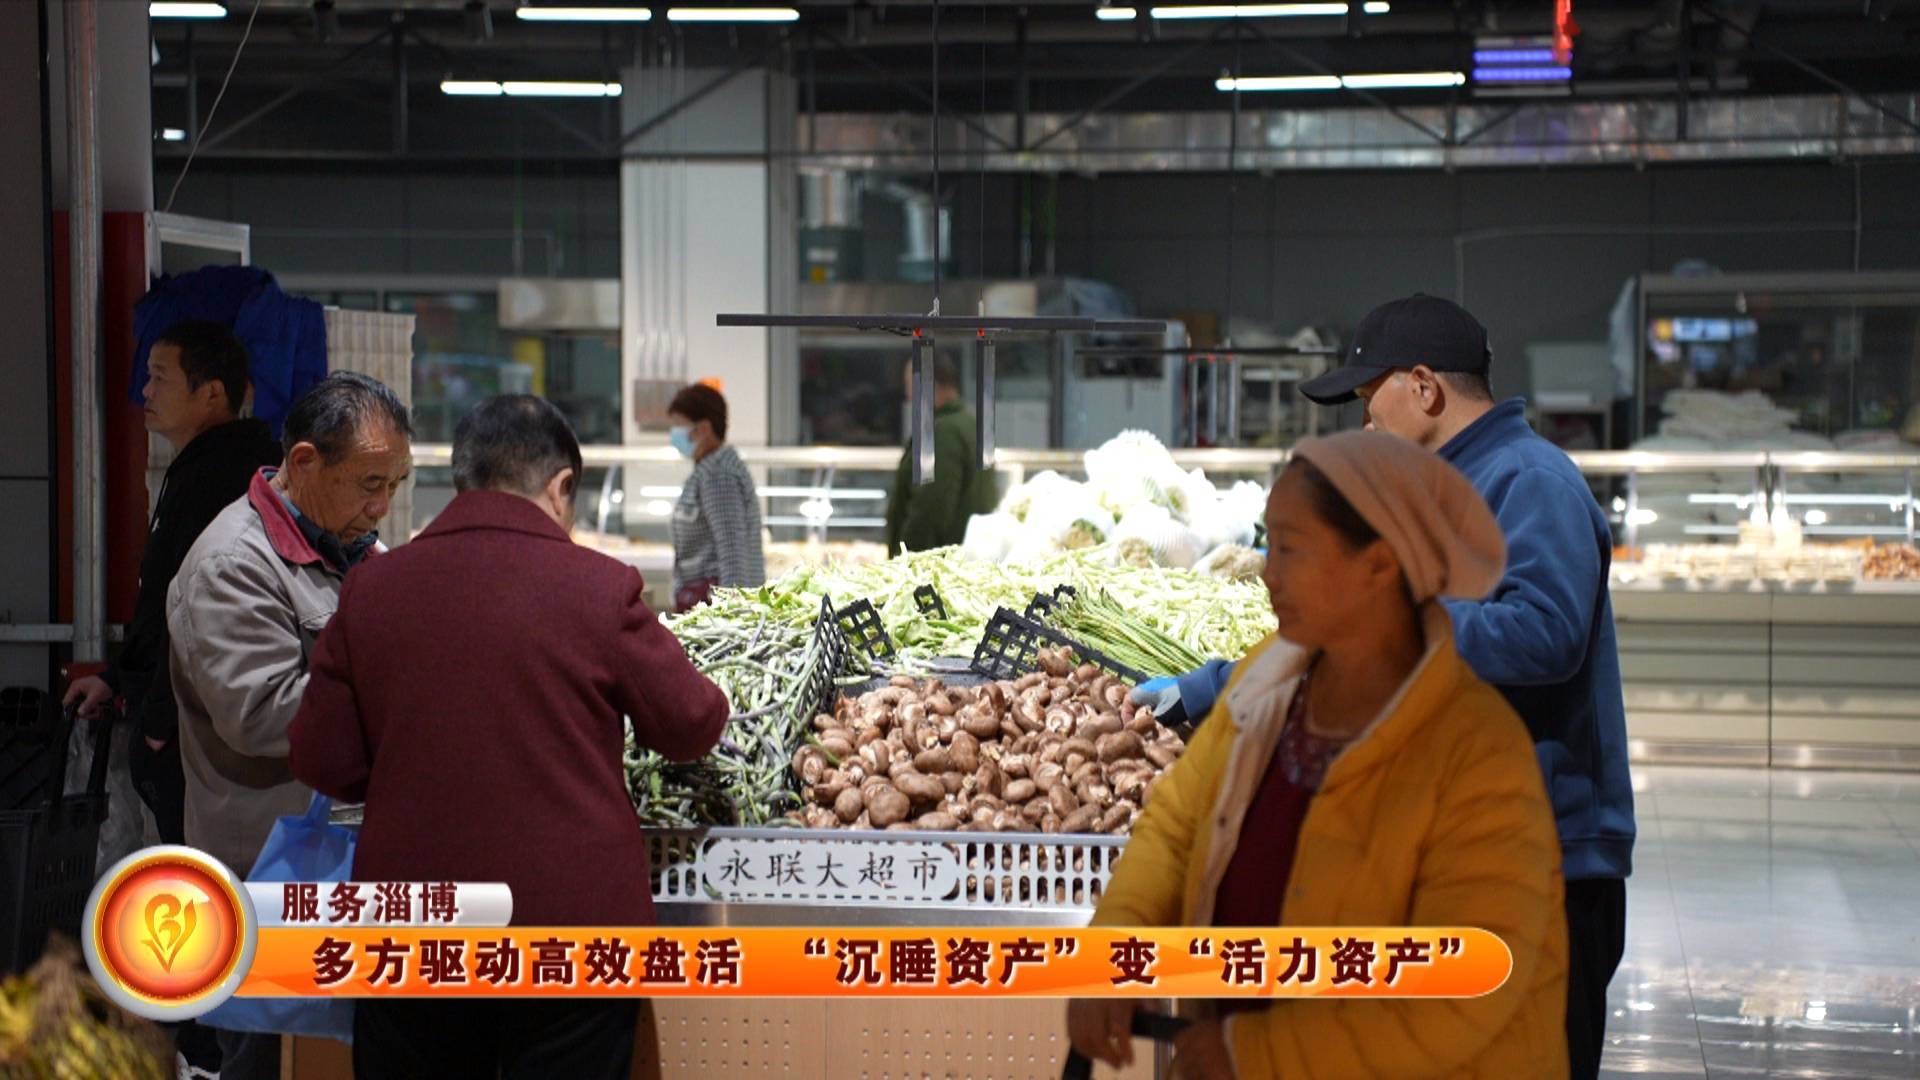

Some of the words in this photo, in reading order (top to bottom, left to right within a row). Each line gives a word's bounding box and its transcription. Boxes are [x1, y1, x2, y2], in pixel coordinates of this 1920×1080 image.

[719, 849, 944, 891] 永联大超市
